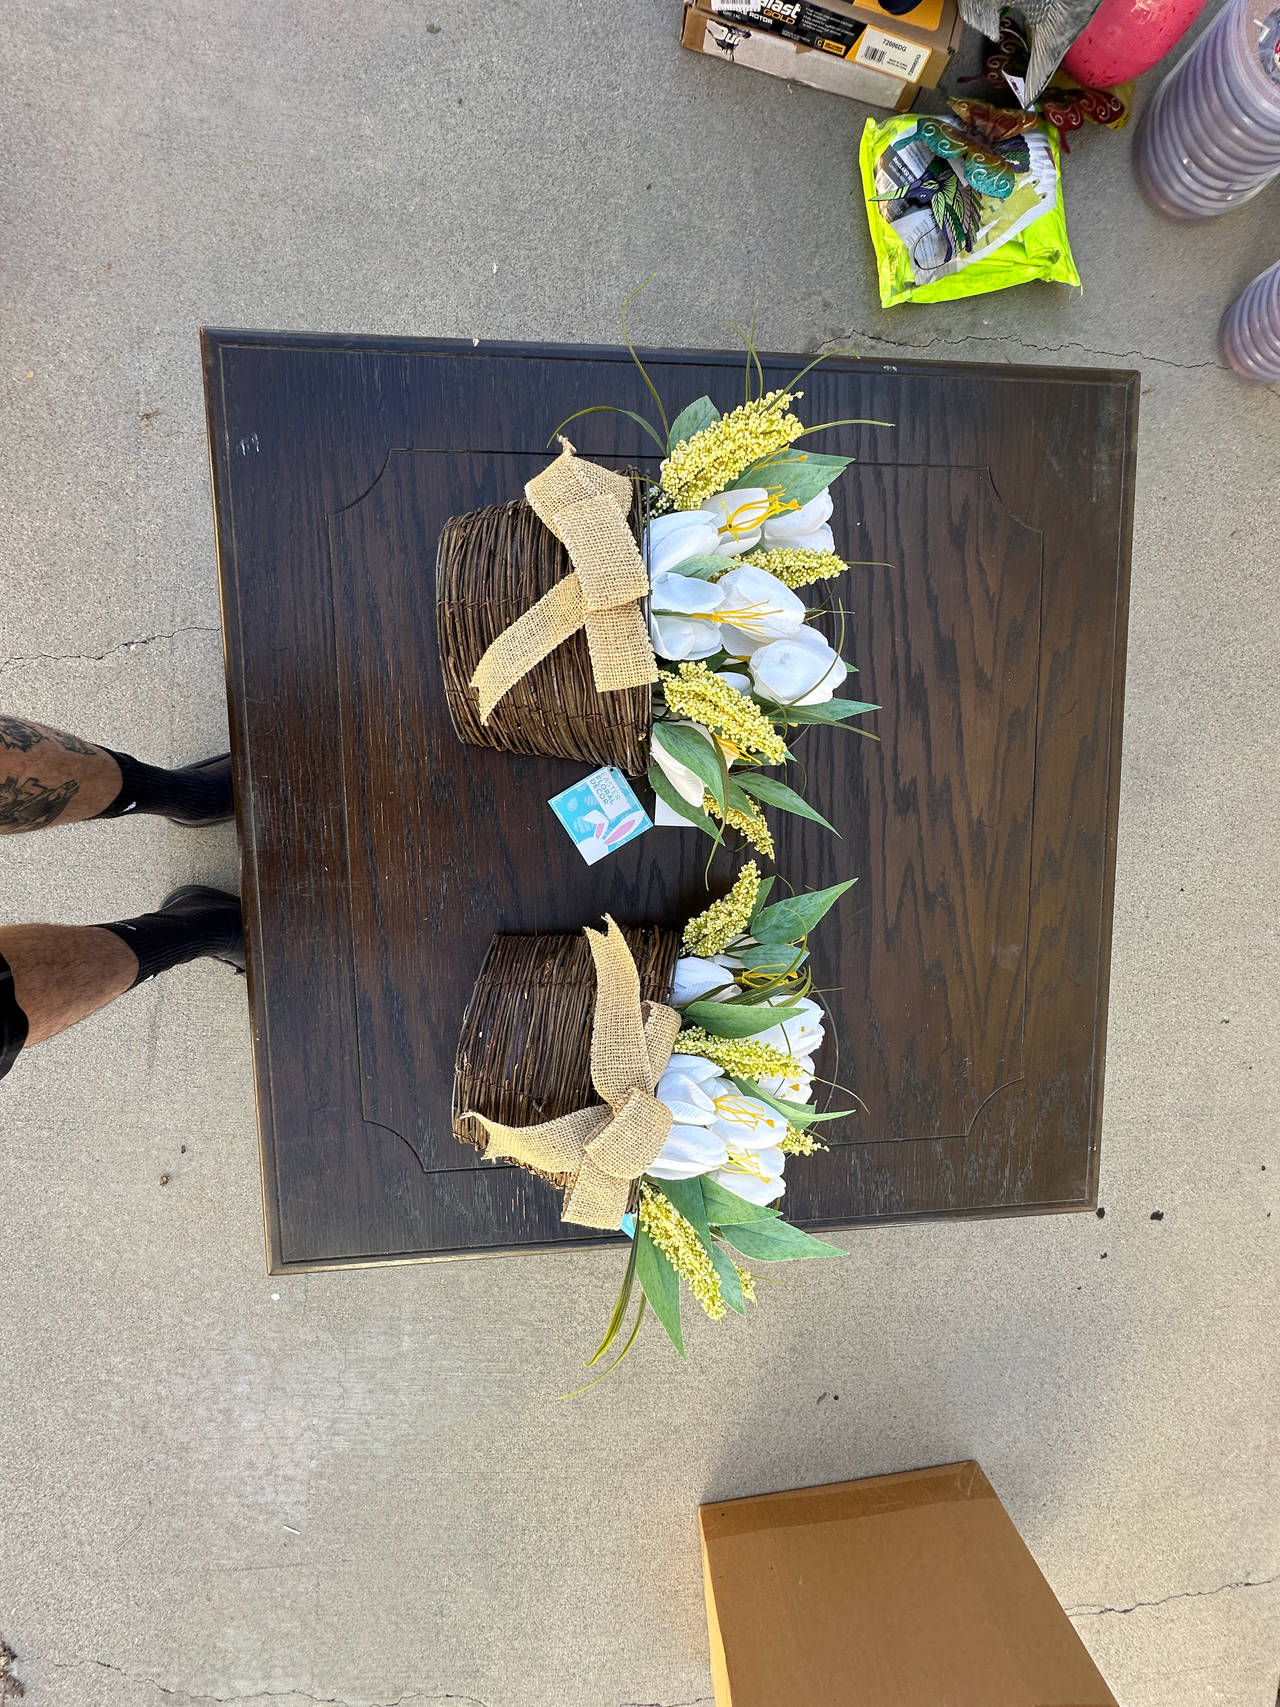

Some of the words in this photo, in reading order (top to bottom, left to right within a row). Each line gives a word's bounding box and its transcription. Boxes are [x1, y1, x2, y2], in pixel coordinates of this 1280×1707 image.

[749, 11, 773, 25] ROTOR
[760, 0, 801, 19] last
[763, 8, 796, 25] GOLD
[882, 38, 907, 52] 72006DG
[595, 775, 615, 805] FLORAL
[600, 772, 621, 800] EASTER
